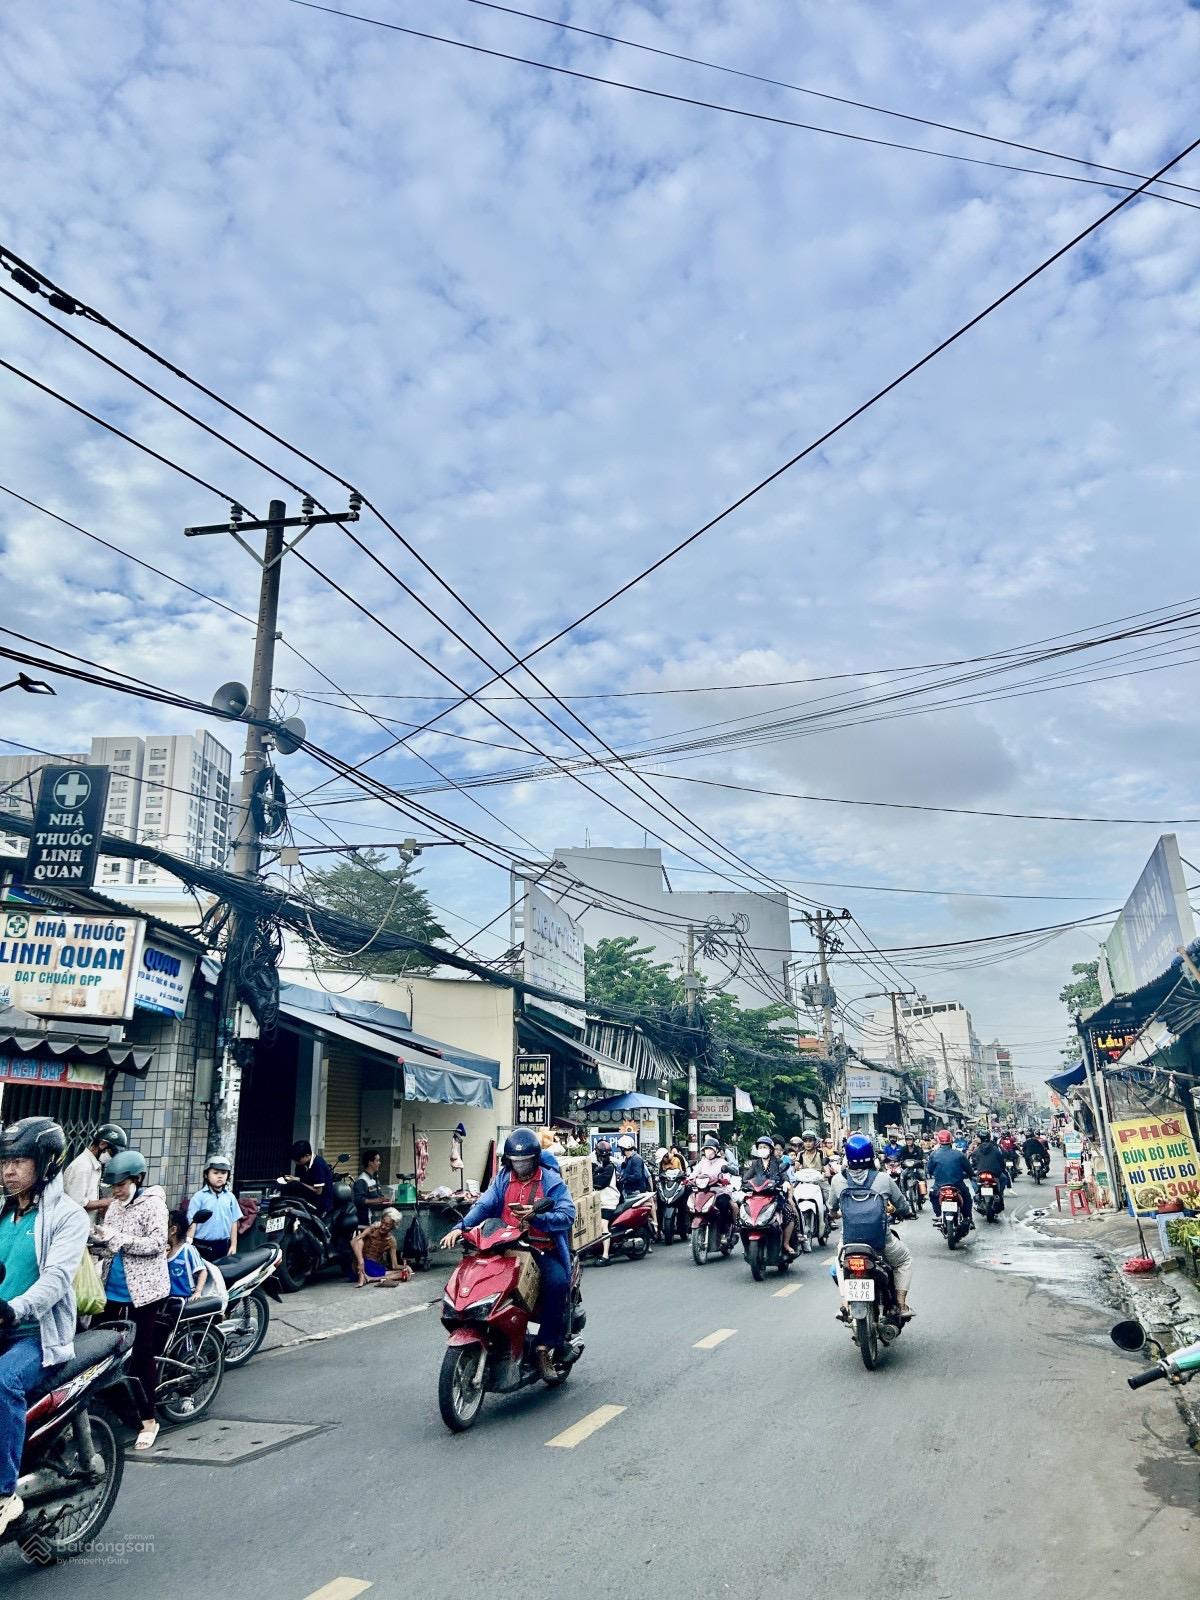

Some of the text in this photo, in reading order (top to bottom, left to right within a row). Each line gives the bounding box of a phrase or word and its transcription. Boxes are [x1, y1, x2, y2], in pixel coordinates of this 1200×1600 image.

[49, 811, 85, 826] NHÀ
[36, 828, 93, 846] THUỐC
[40, 849, 82, 862] LINH
[33, 865, 84, 880] QUAN
[34, 920, 126, 942] NHÀ THUỐC
[0, 941, 125, 970] LINH QUAN
[15, 969, 102, 986] ĐẠT CHUẨN GPP
[519, 1073, 545, 1088] NGỌC
[1118, 1117, 1181, 1143] PHỞ
[1122, 1137, 1191, 1165] BÚN BÒ HUẾ
[1128, 1165, 1147, 1184] HỦ
[1178, 1159, 1197, 1178] BÒ
